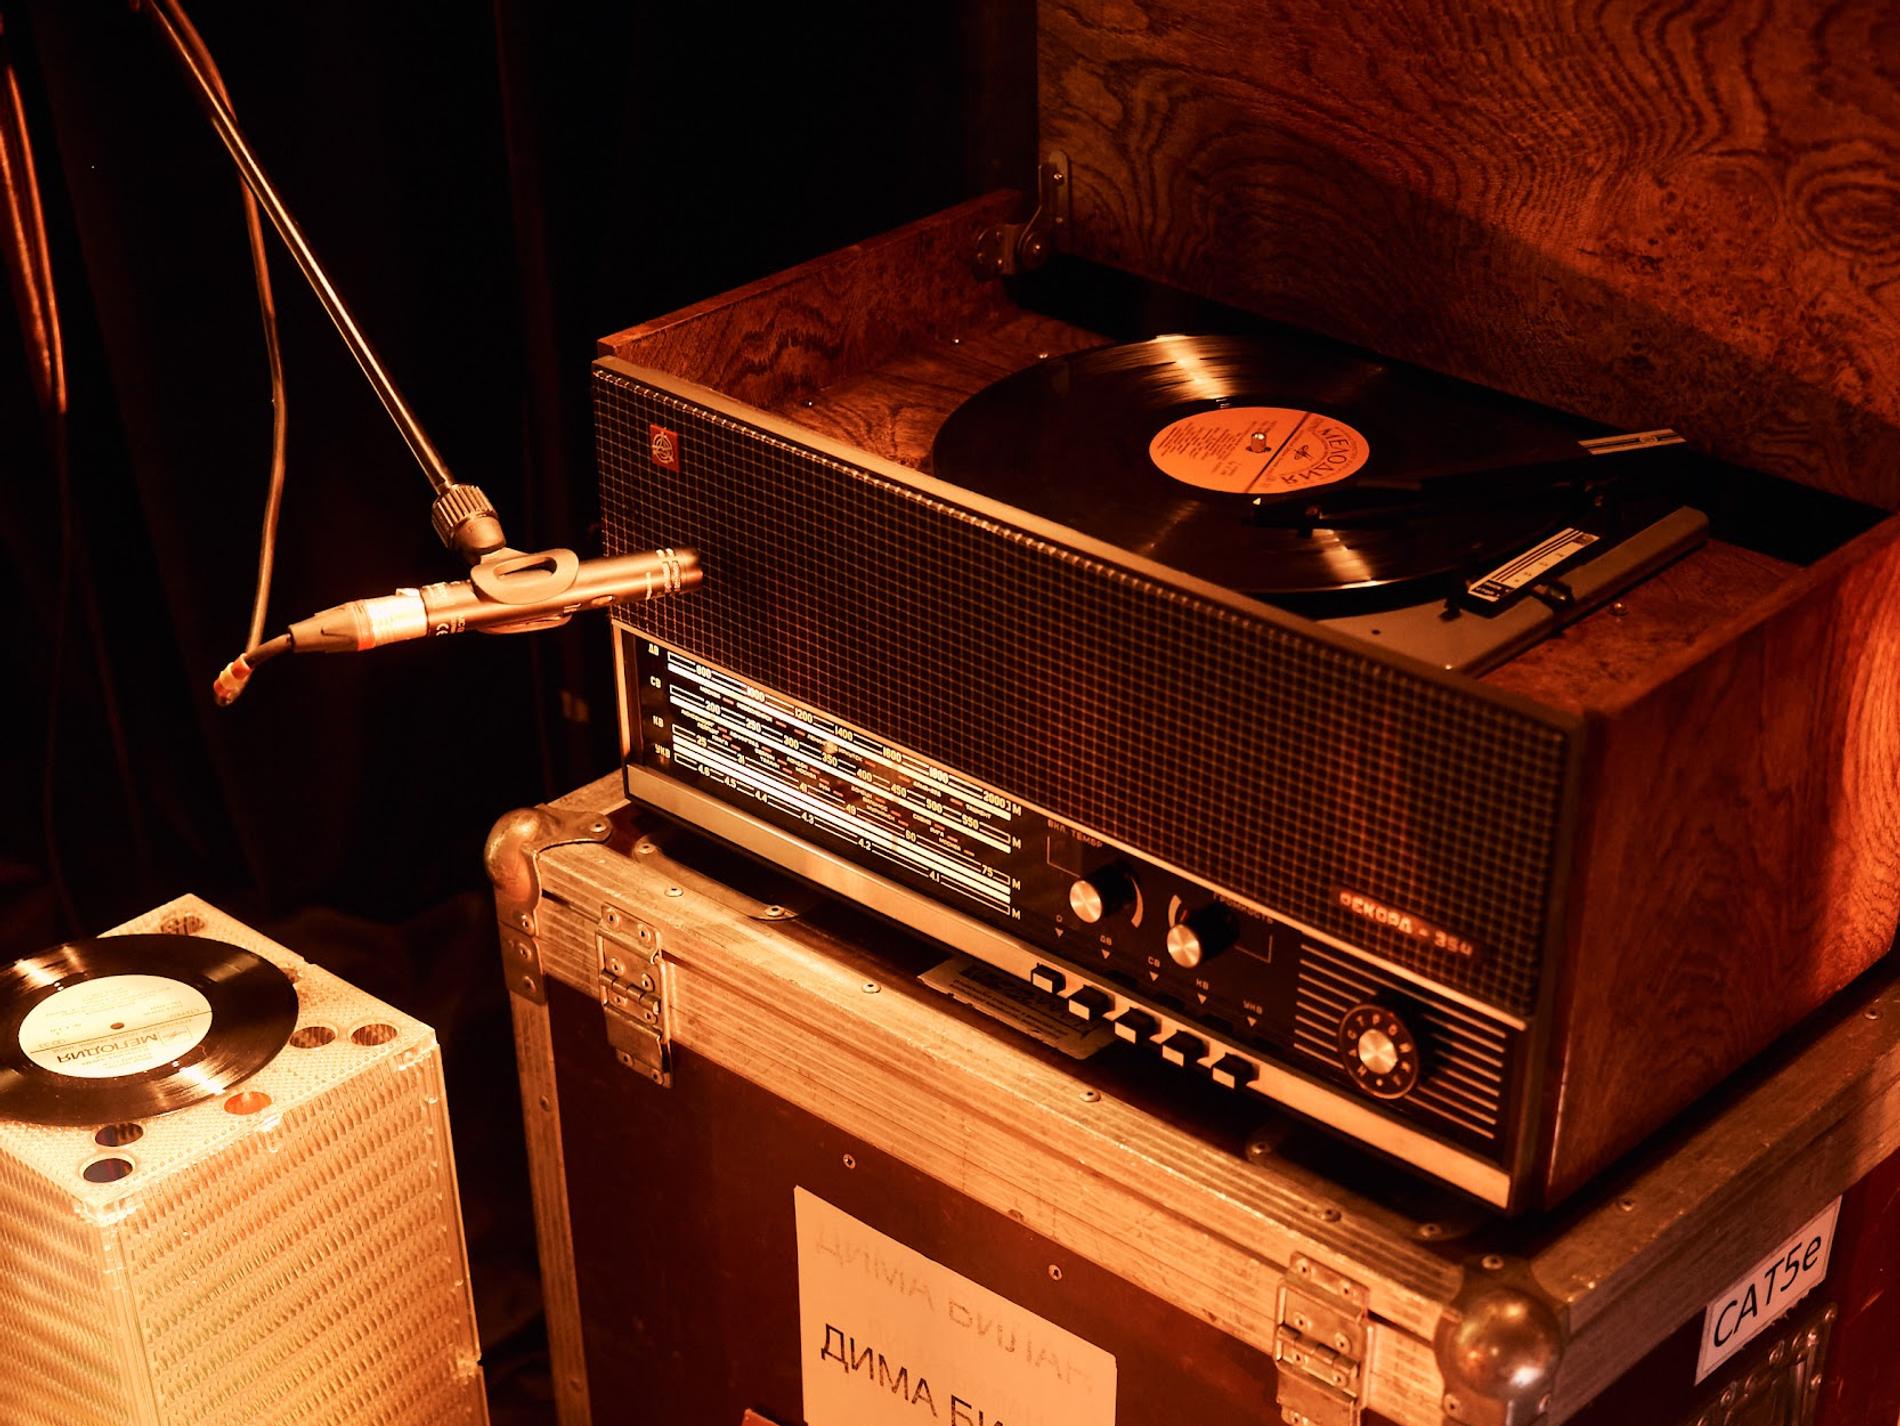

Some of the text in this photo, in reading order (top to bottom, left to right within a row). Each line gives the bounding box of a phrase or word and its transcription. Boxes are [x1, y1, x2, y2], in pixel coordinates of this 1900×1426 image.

[1280, 427, 1350, 485] МЕЛОДИЯ
[704, 700, 721, 715] 200
[821, 752, 839, 767] 350
[856, 768, 873, 783] 400
[890, 783, 907, 799] 450
[926, 798, 944, 814] 500
[961, 813, 980, 830] 550
[794, 707, 813, 724] 1200
[834, 725, 854, 742] 1400
[983, 790, 1006, 809] 2000
[982, 864, 994, 878] 75
[1148, 956, 1160, 968] СВ
[56, 1033, 159, 1064] МЕЛОДИЯ
[1713, 1235, 1822, 1348] CAT5e
[820, 1323, 938, 1419] ДИМА
